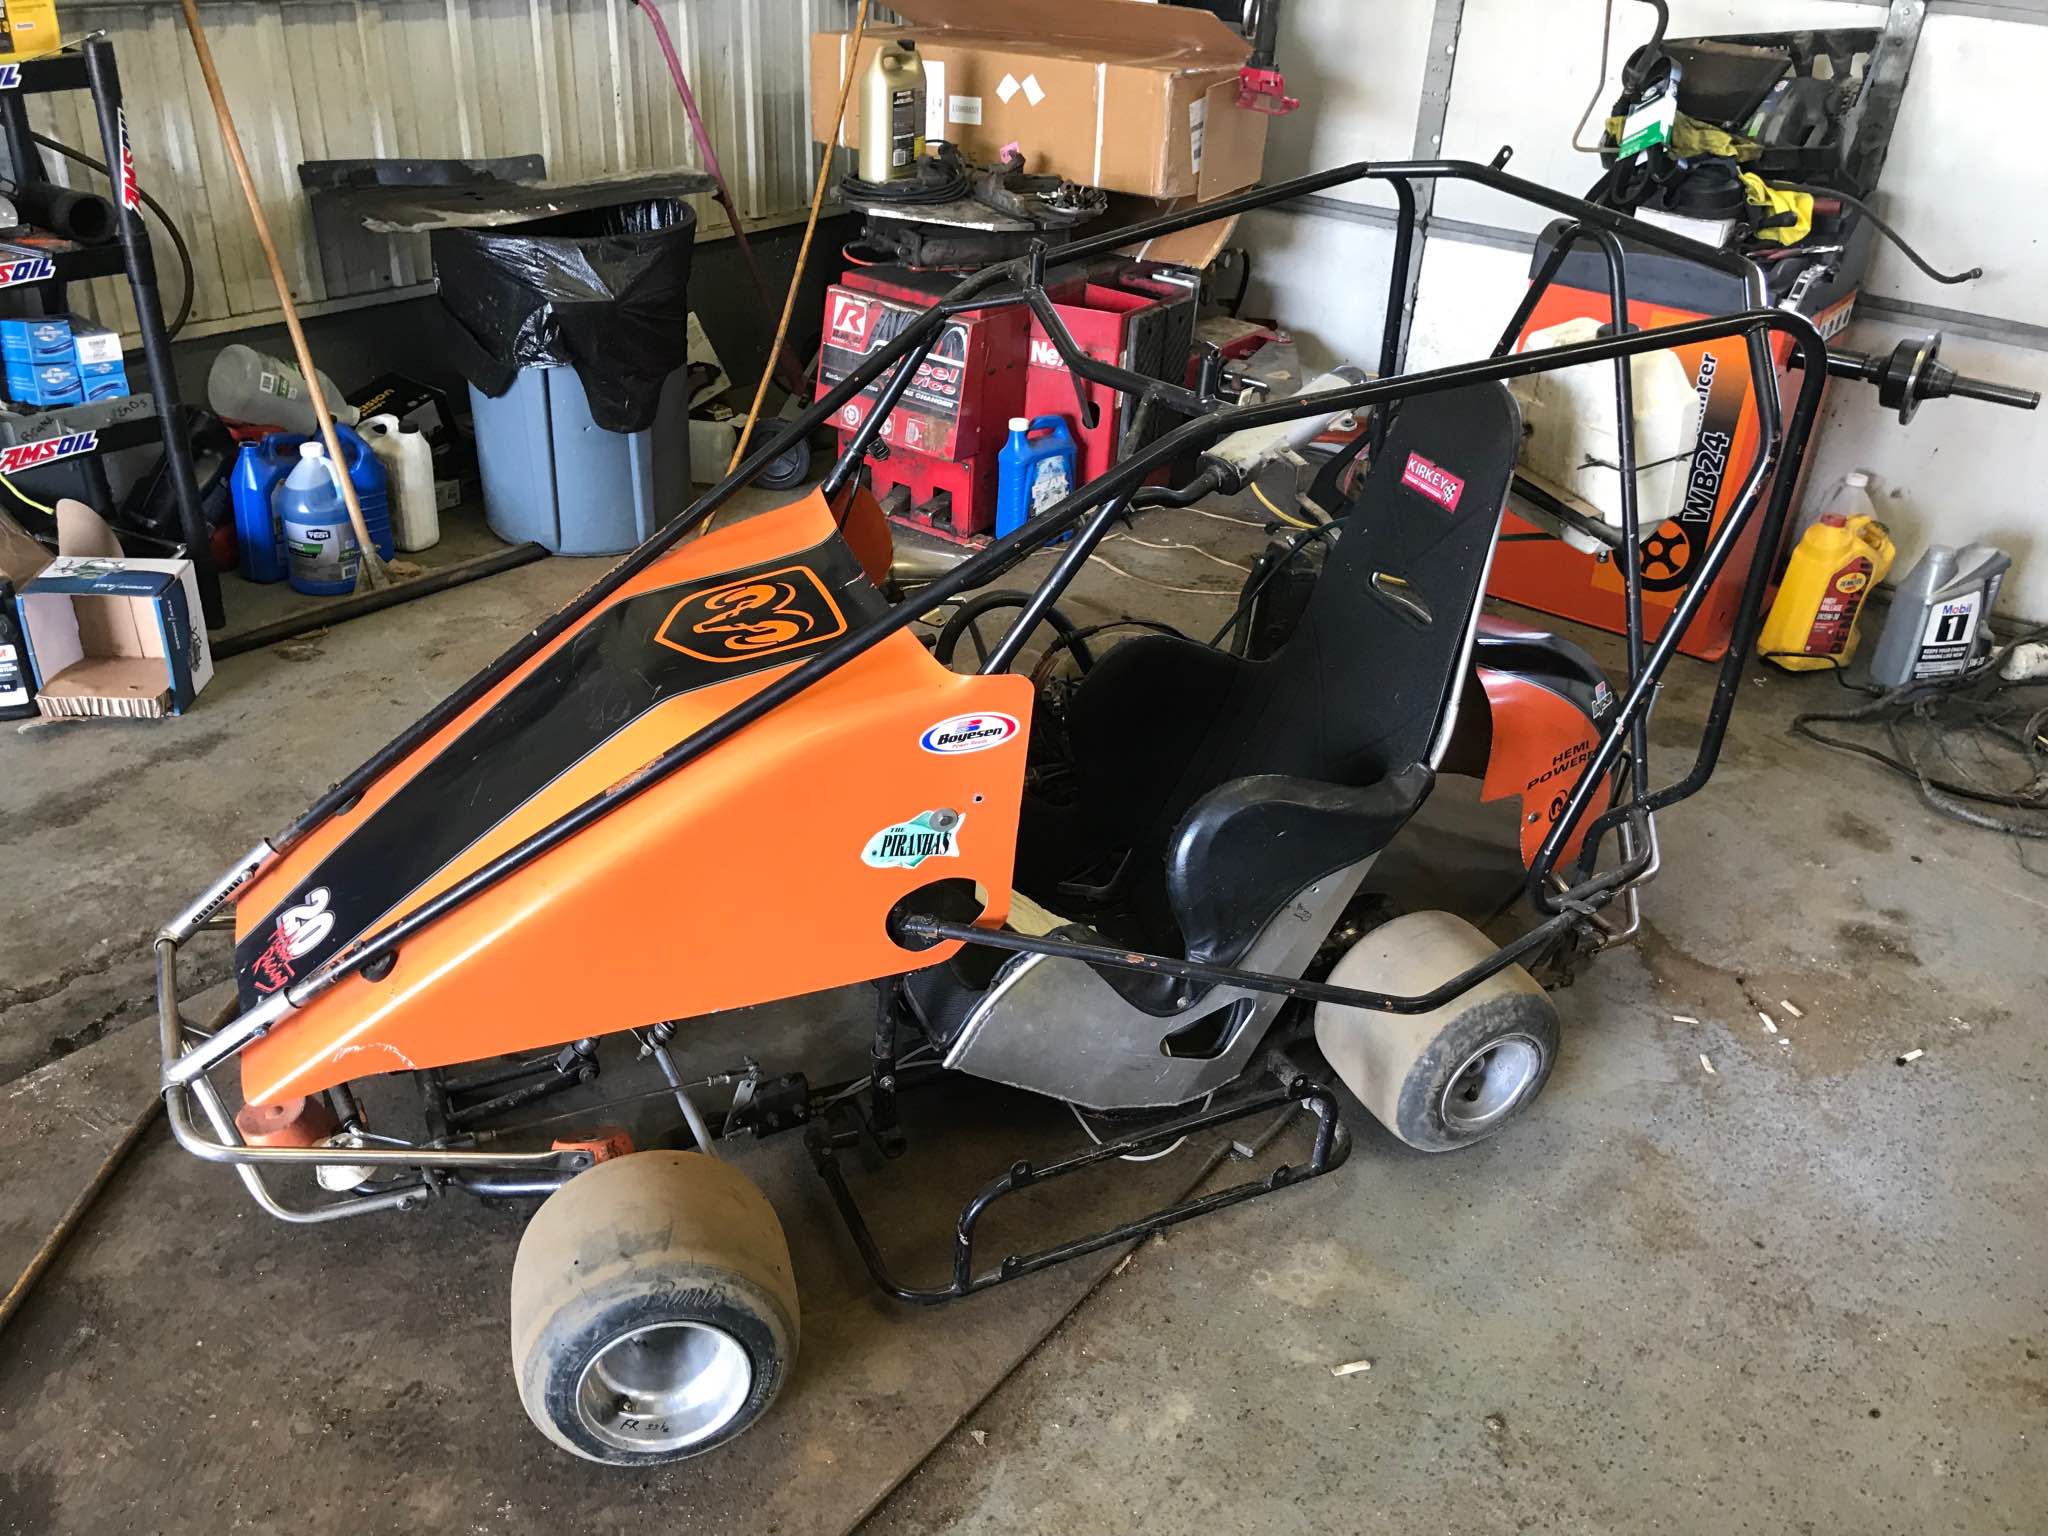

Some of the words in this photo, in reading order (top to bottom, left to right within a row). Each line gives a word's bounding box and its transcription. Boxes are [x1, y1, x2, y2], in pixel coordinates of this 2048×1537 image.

[0, 431, 96, 471] AMSOIL
[1407, 458, 1449, 490] KIRKEY
[1682, 431, 1730, 523] WB24
[1942, 602, 1973, 615] Mobil
[1946, 616, 1960, 641] 1
[937, 727, 1003, 746] Boyesen
[1552, 740, 1590, 767] HEMI
[1526, 750, 1596, 792] POWER
[879, 831, 952, 858] PIRANHAS
[276, 885, 336, 960] 20
[620, 1418, 640, 1432] FR
